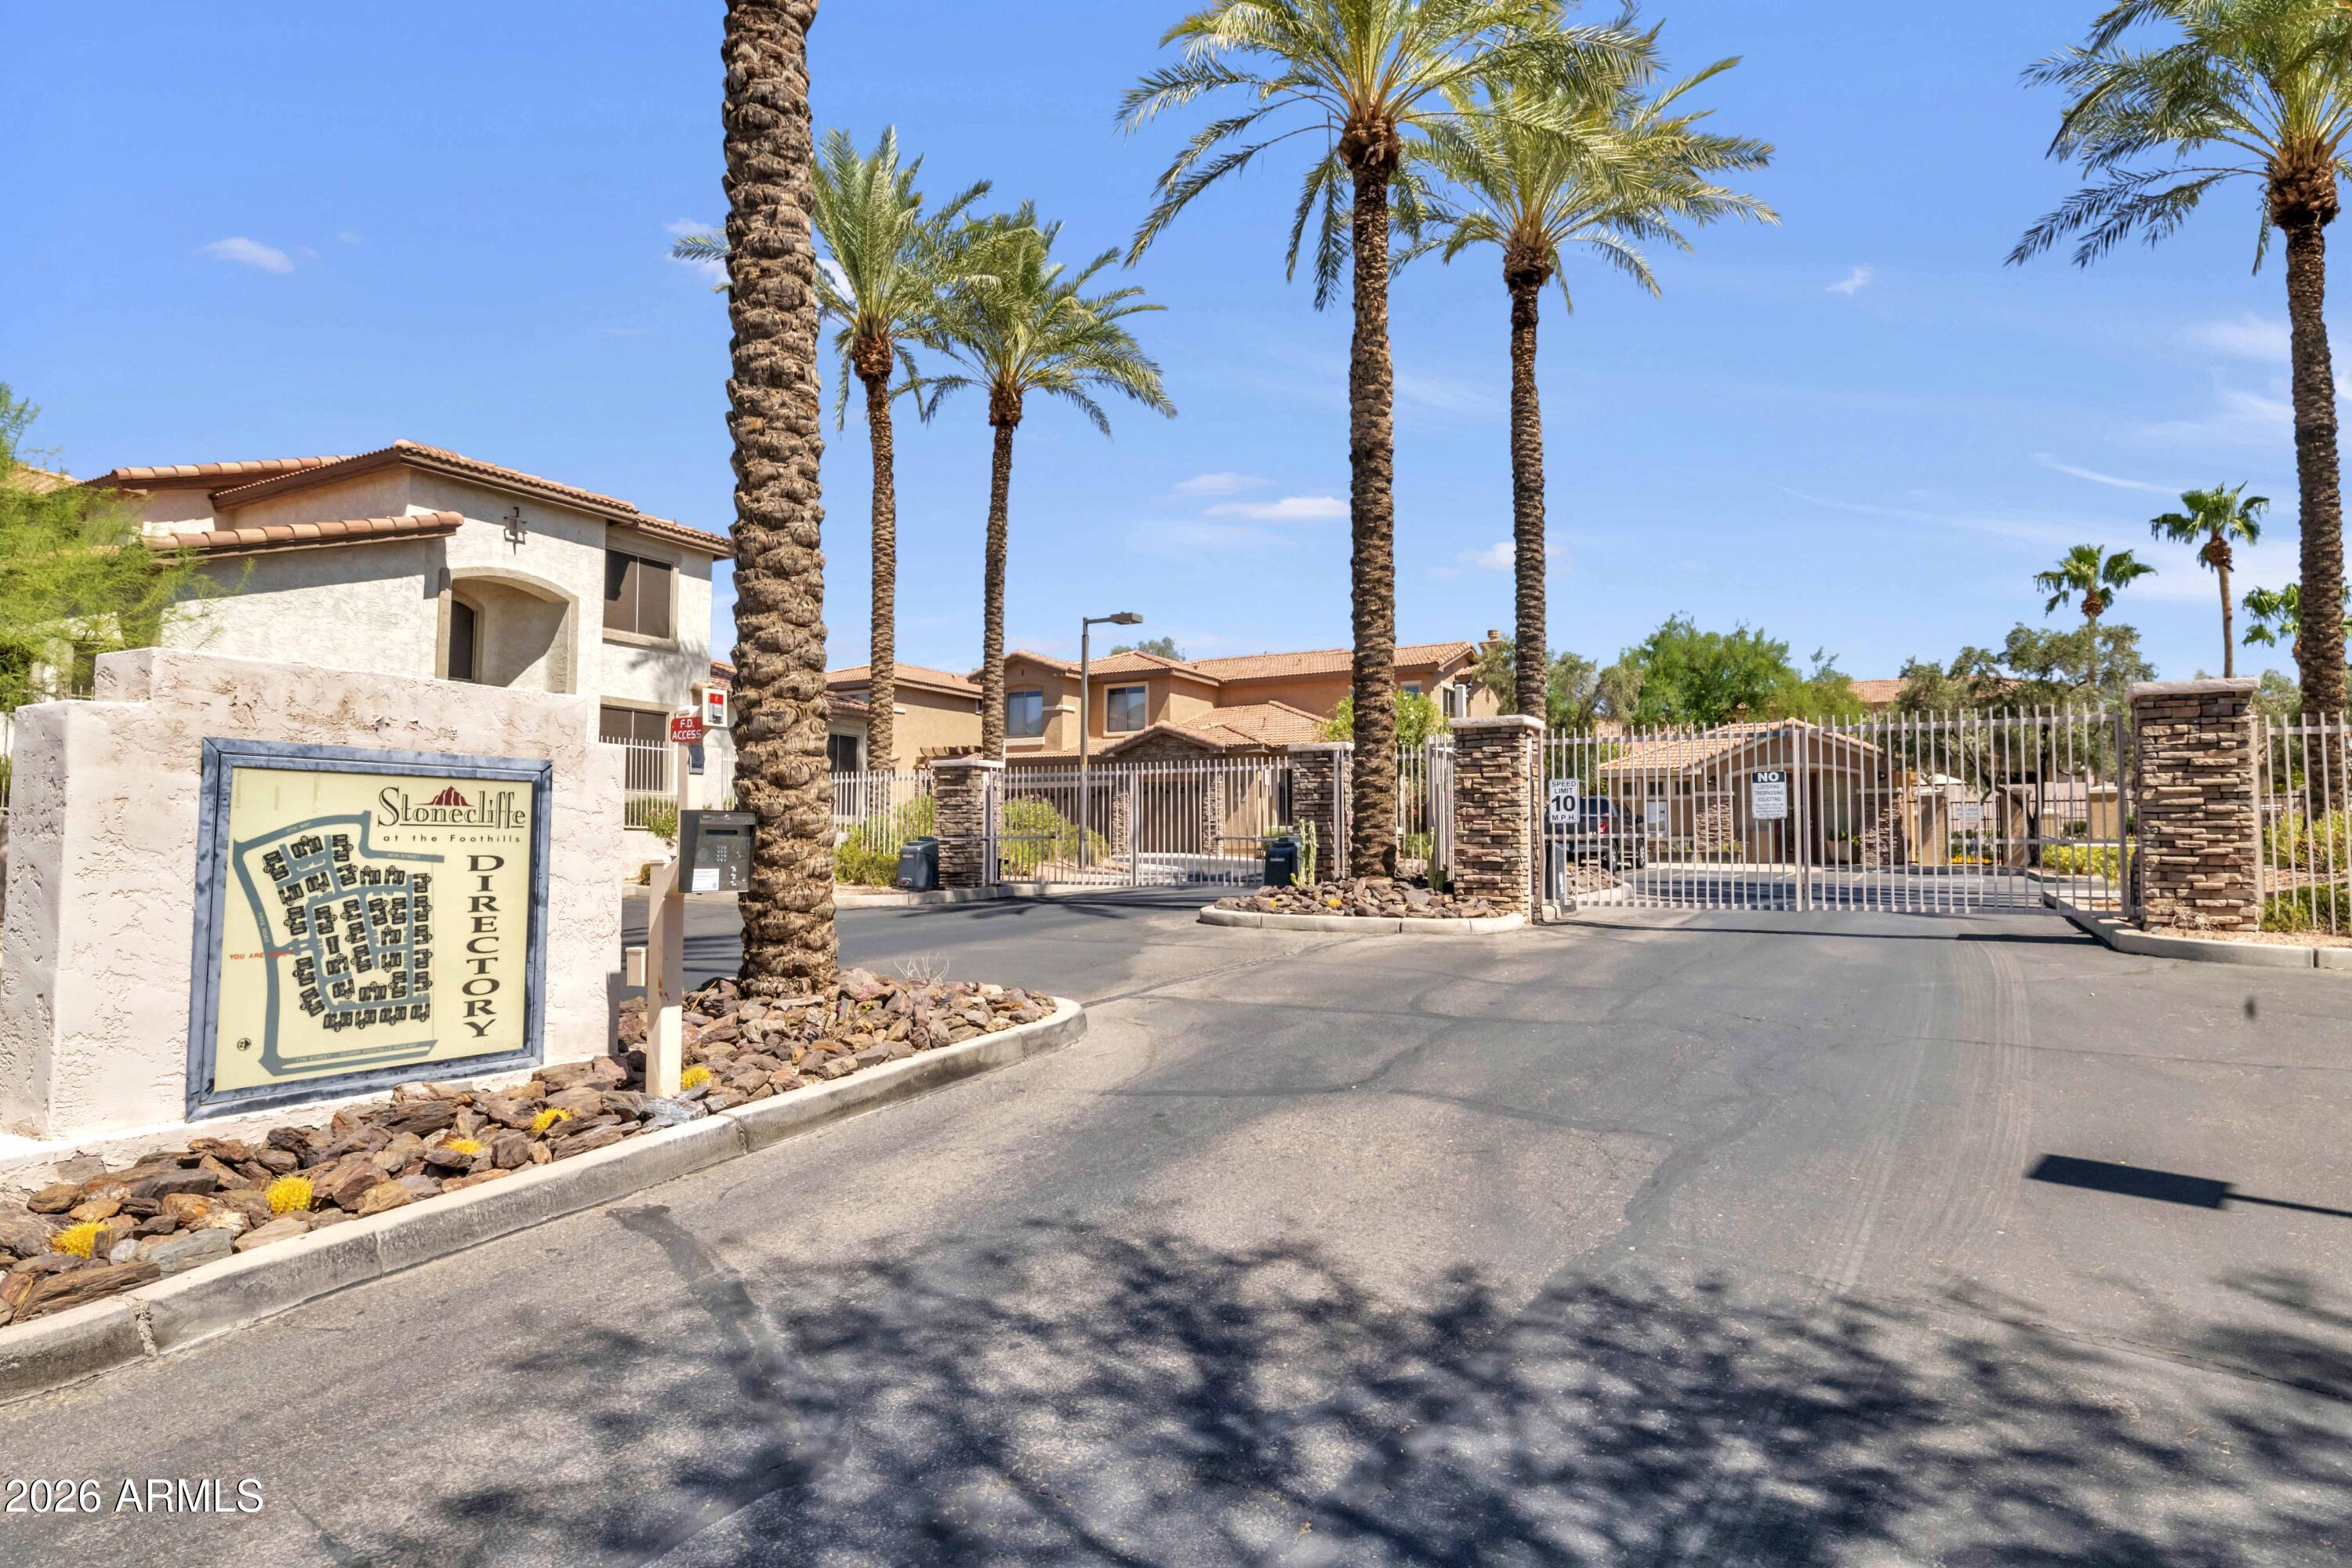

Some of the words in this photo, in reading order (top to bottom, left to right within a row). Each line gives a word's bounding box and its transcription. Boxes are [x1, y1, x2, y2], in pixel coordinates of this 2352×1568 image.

[680, 718, 695, 728] F.D.
[672, 730, 702, 740] ACCESS
[1757, 771, 1780, 782] NO
[377, 786, 526, 829] Stonecliffe
[1551, 795, 1576, 812] 10
[450, 834, 521, 843] Foothills
[462, 855, 505, 1038] DIRECTORY
